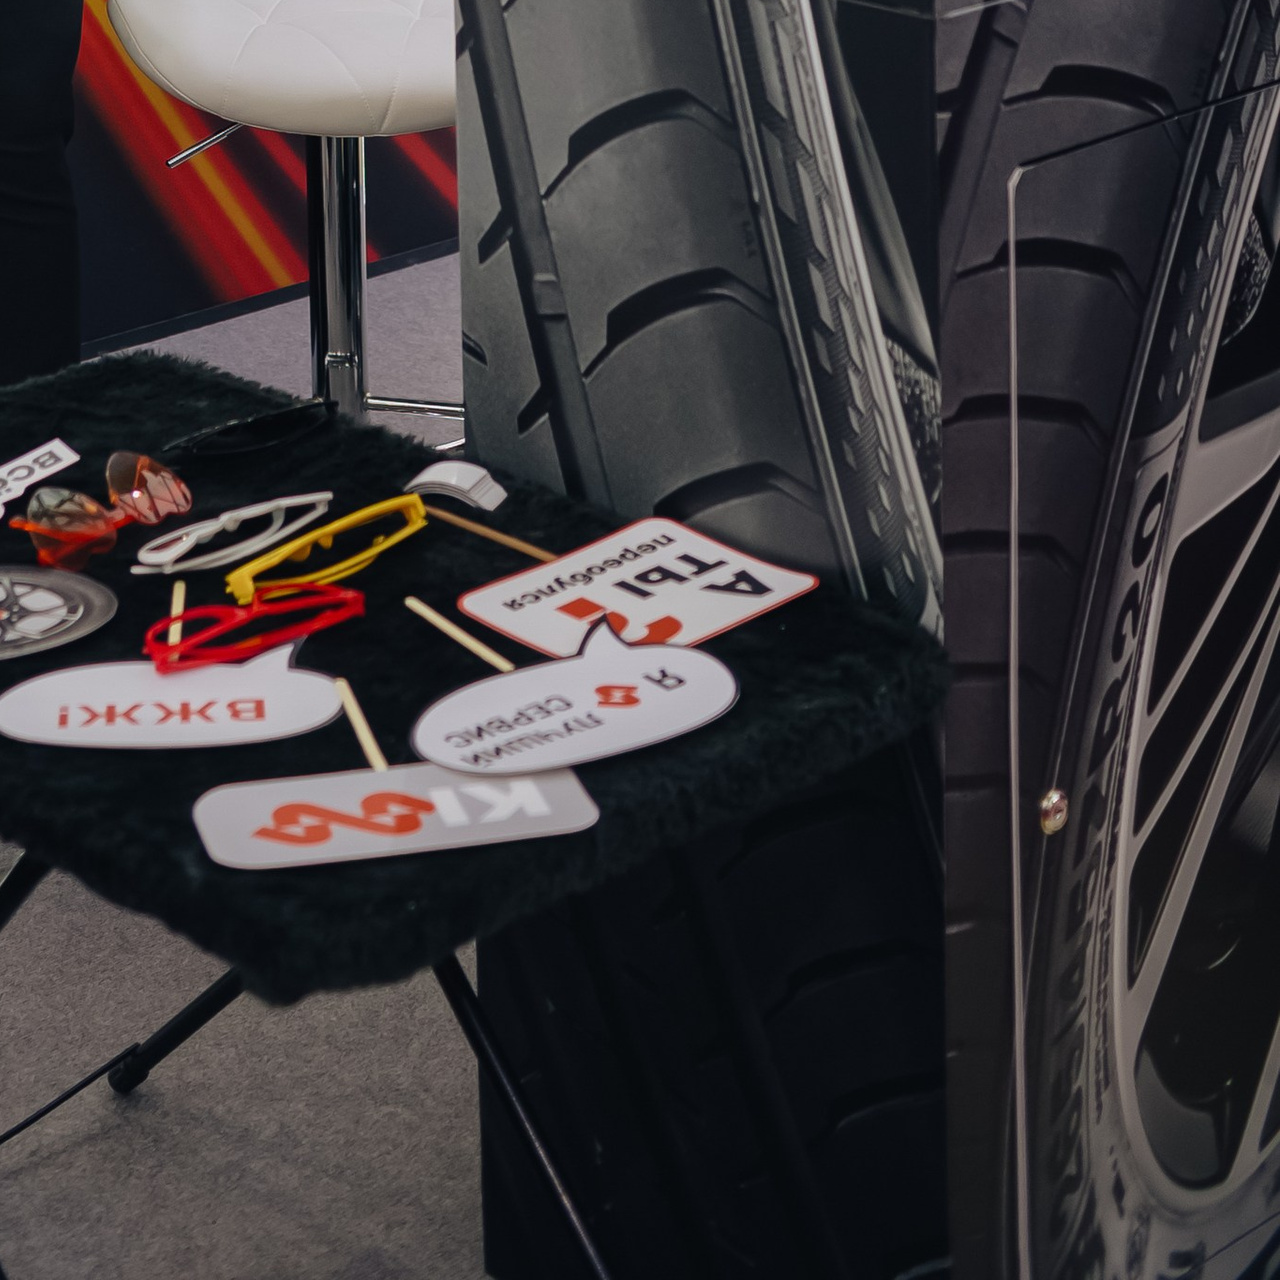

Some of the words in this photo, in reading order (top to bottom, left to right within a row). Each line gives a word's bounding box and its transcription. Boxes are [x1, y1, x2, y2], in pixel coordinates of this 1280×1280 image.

[502, 533, 677, 613] переобулся
[613, 553, 730, 600] ТЫ
[700, 569, 774, 598] А
[644, 668, 686, 692] Я
[444, 694, 572, 750] СЕРВИС
[460, 712, 605, 769] ЛУЧШИЙ
